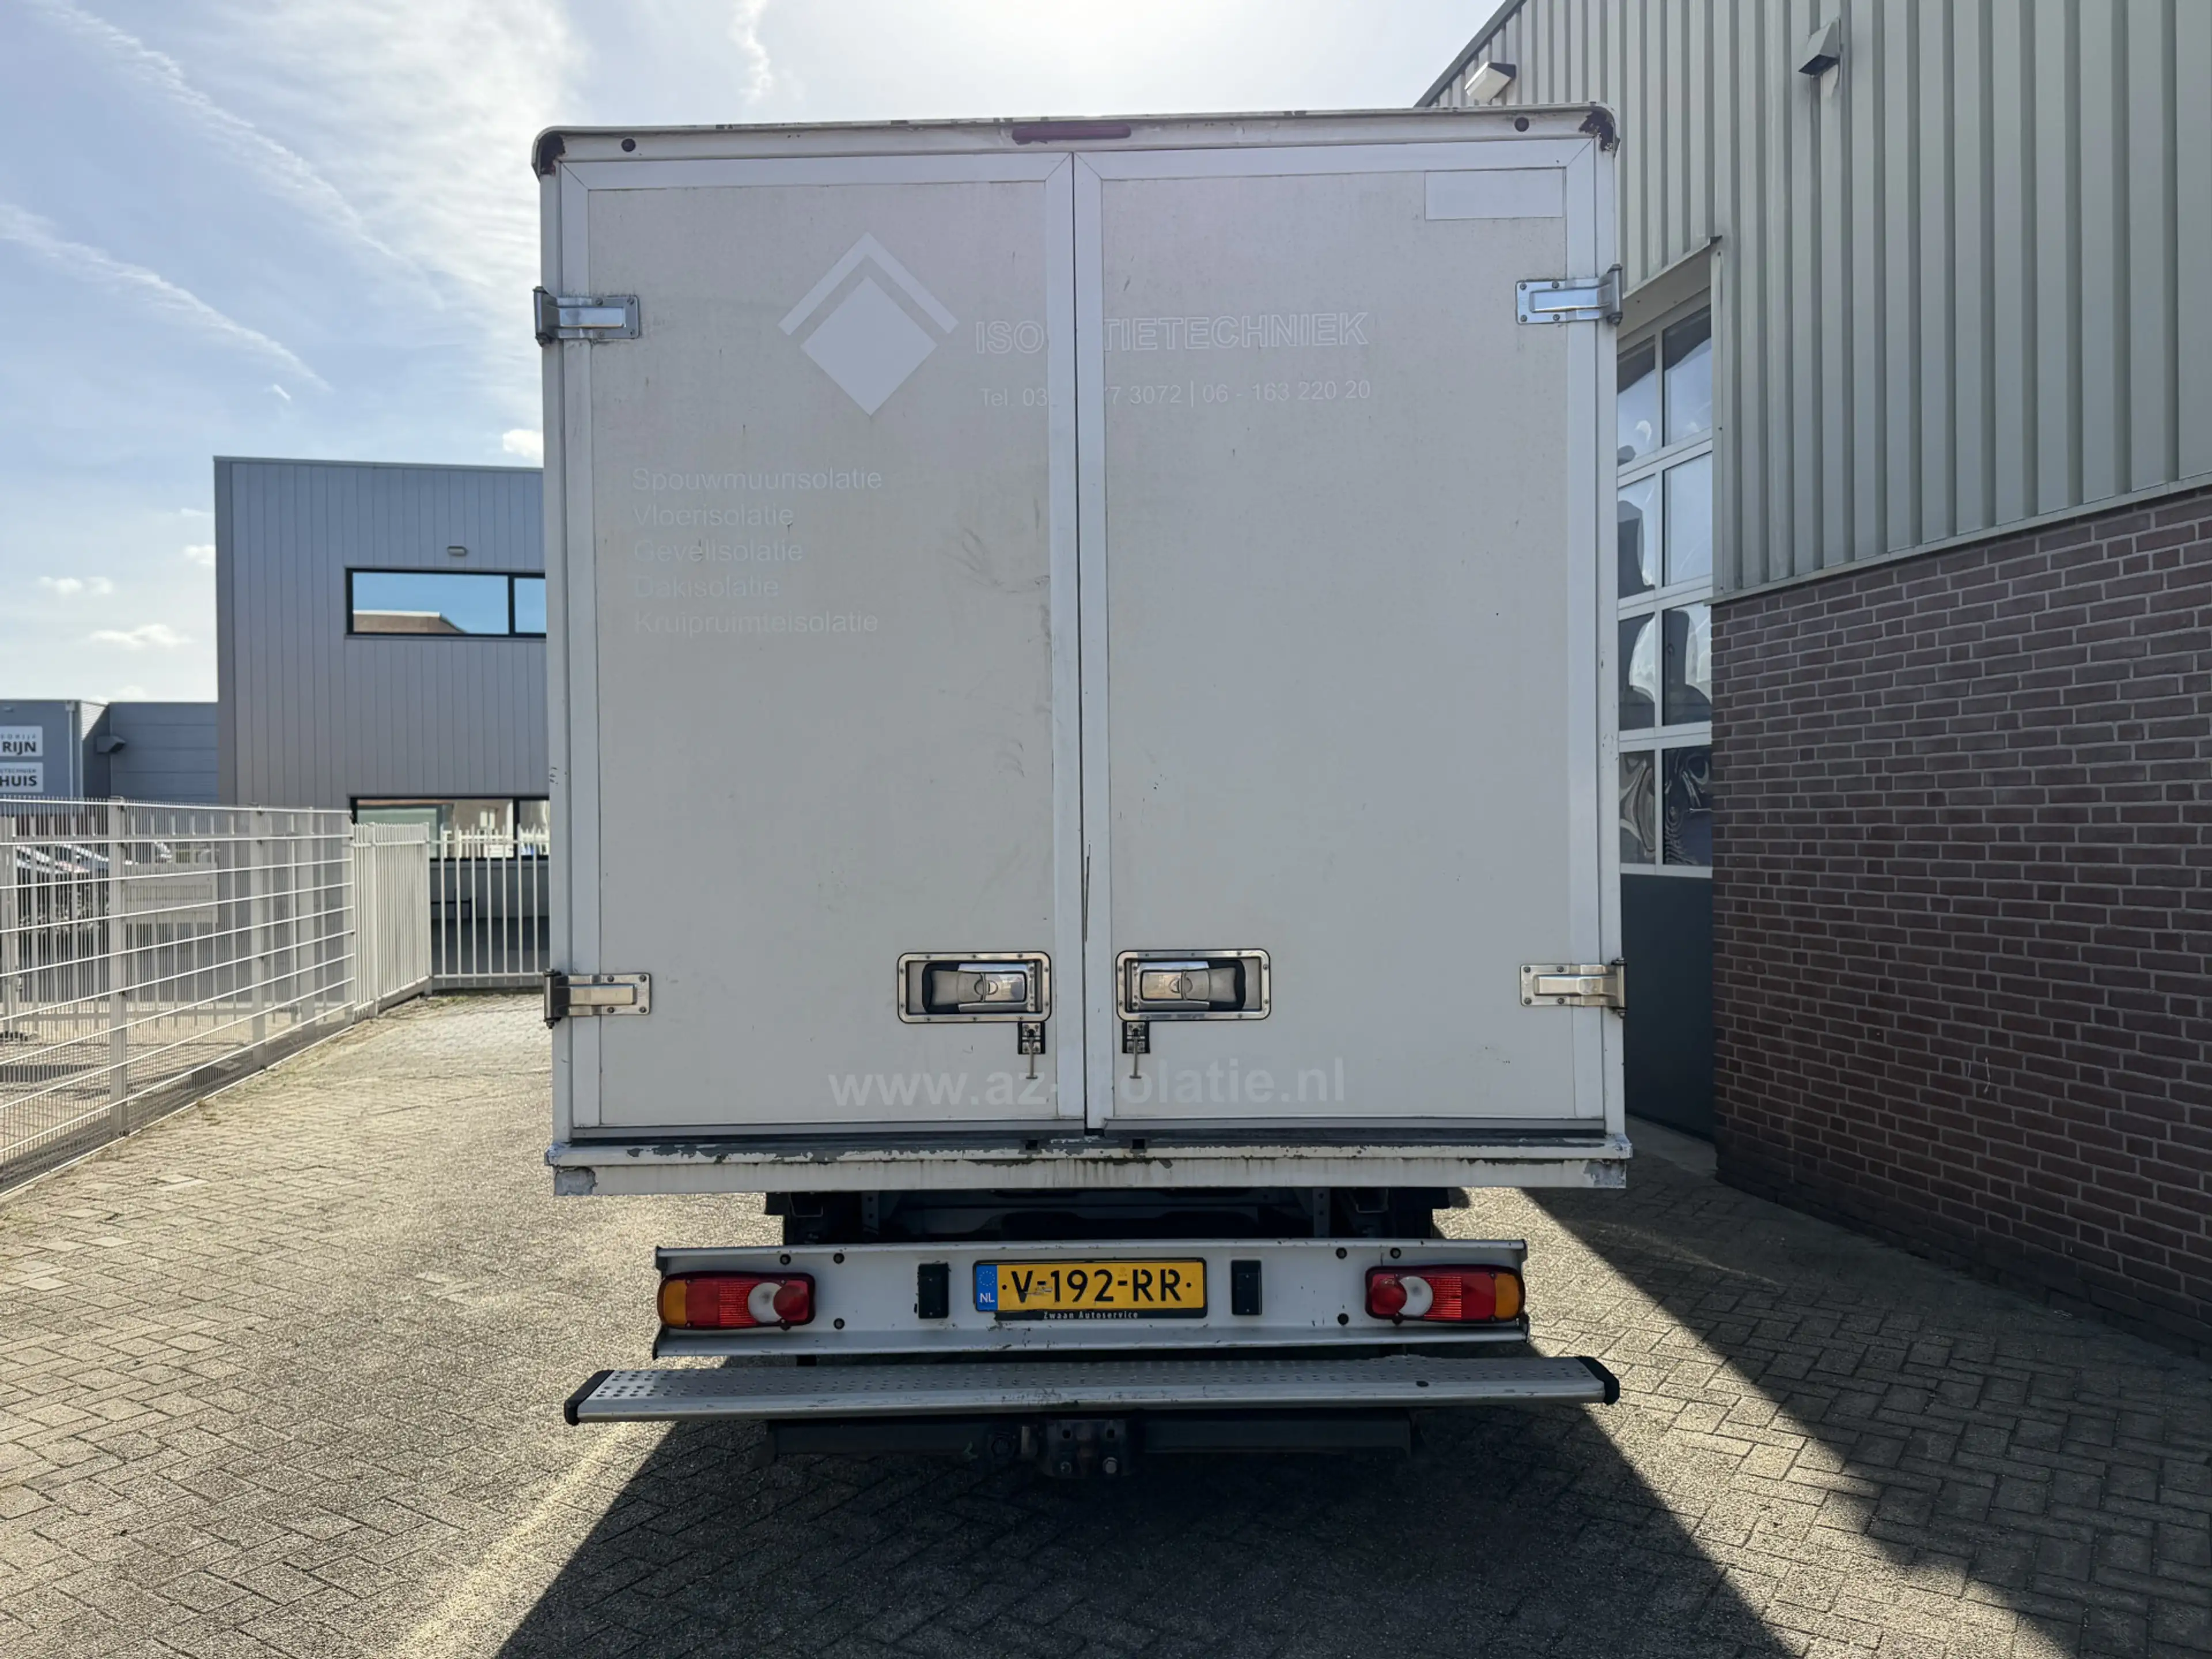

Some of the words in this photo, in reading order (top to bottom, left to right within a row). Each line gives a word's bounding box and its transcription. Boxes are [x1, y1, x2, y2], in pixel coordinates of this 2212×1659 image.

[1130, 385, 1182, 404] 3072
[1203, 384, 1229, 403] 06
[1252, 382, 1290, 402] 163
[1297, 381, 1337, 401] 220
[1345, 380, 1372, 400] 20
[2, 741, 37, 755] RIJN
[1011, 1268, 1181, 1304] V-192-RR
[980, 1292, 995, 1303] NL
[1043, 1310, 1074, 1319] Zwaan
[1078, 1310, 1138, 1319] Autoservice
